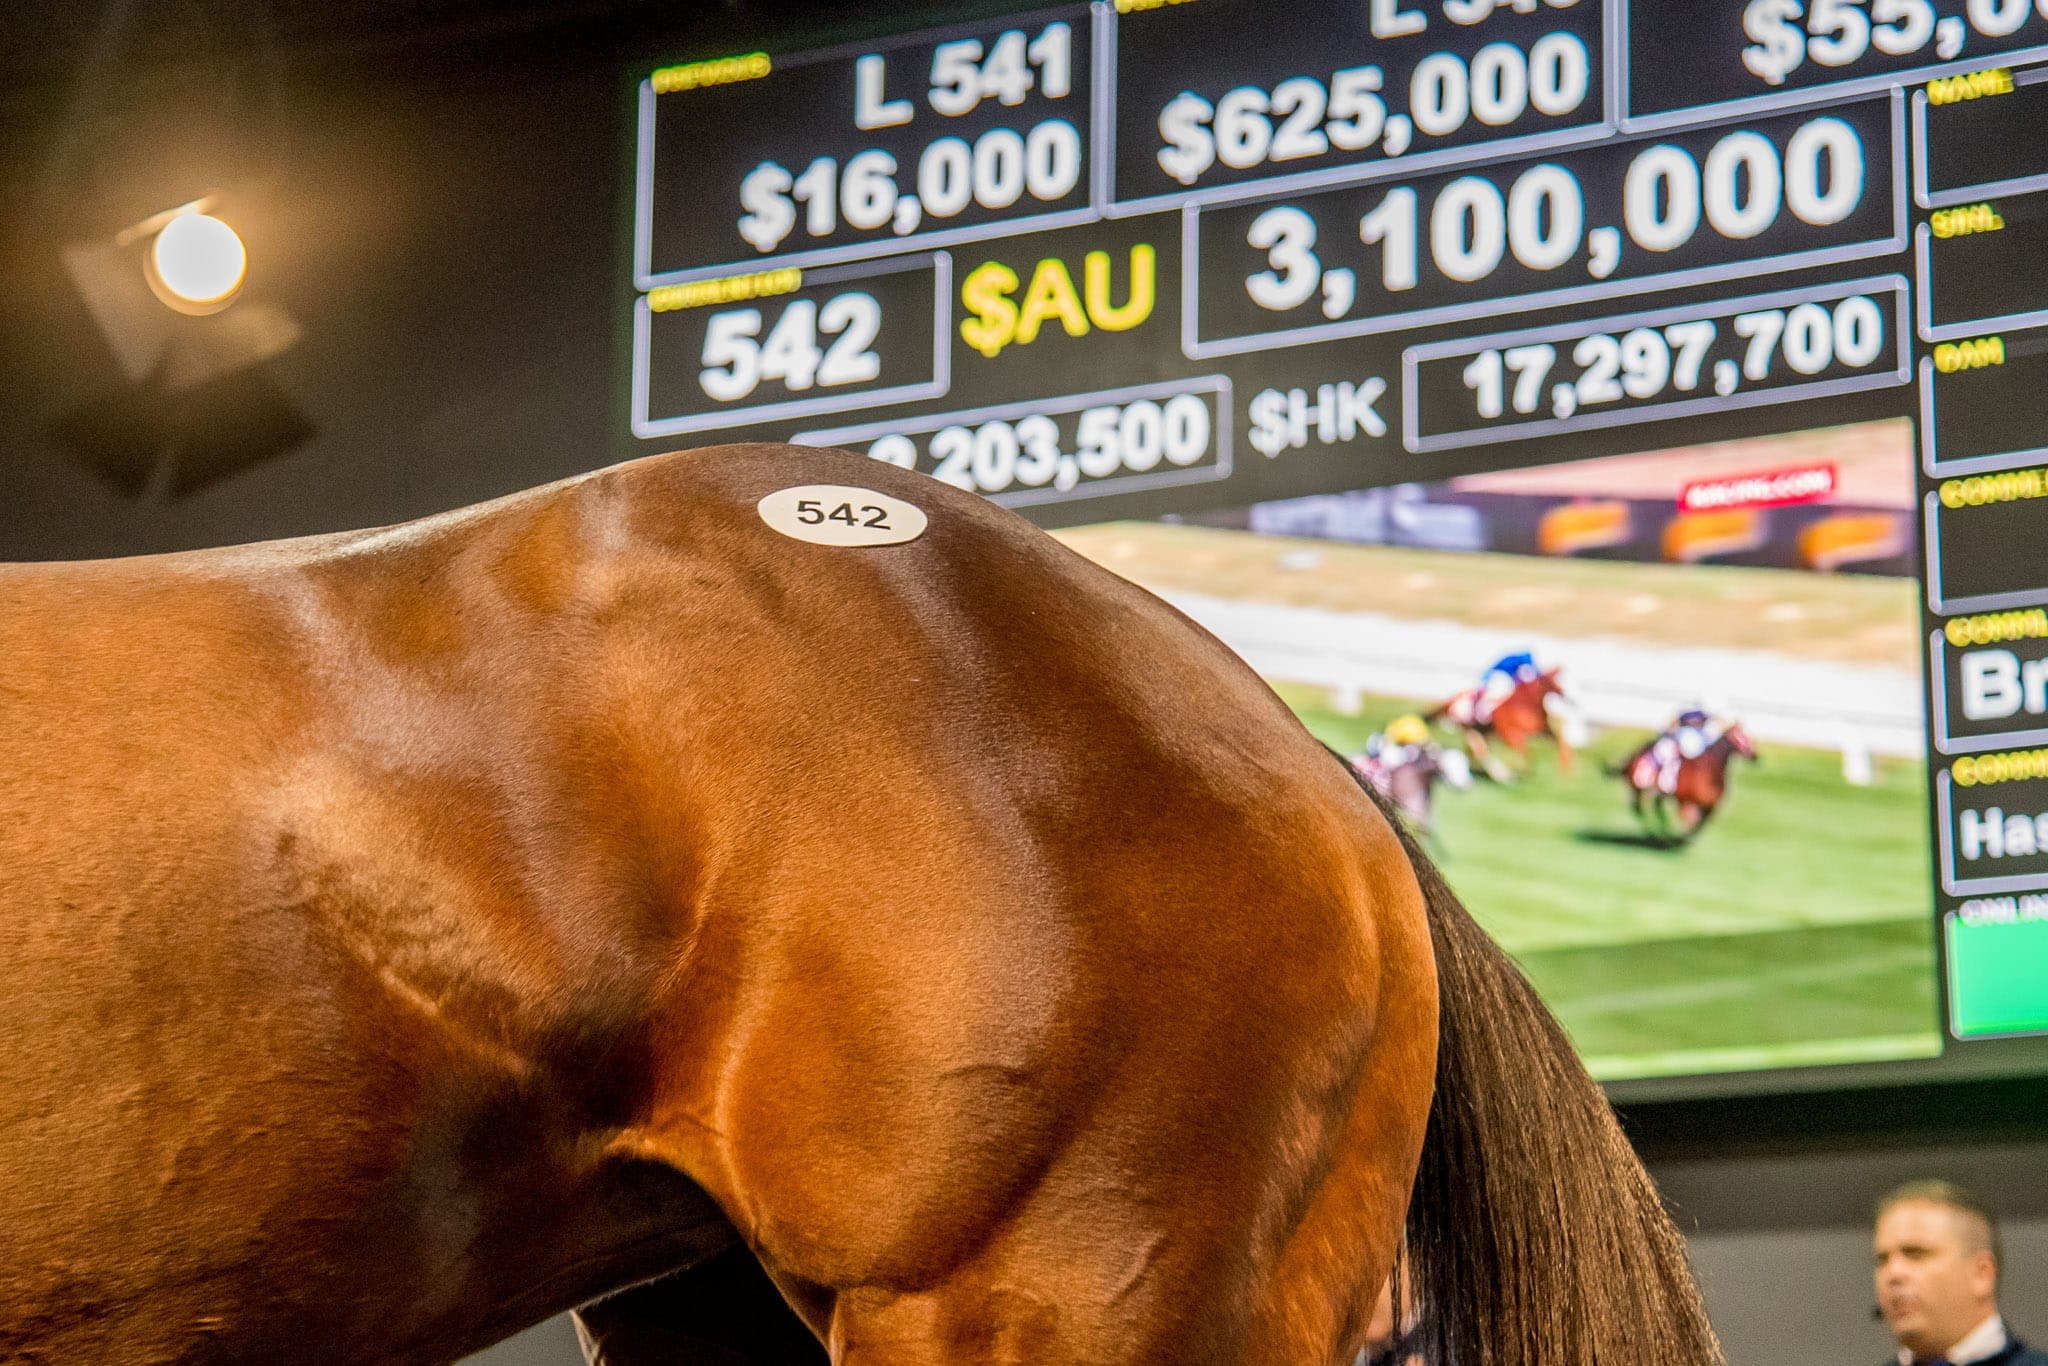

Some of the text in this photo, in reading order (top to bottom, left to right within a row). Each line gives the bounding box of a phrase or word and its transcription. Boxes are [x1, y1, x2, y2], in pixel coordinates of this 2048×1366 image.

[855, 53, 914, 130] L
[927, 21, 1072, 117] 541
[1157, 30, 1590, 186] $625,000
[738, 118, 1081, 252] $16,000
[1245, 116, 1865, 320] 3,100,000
[700, 292, 882, 402] 542
[960, 244, 1156, 358] $AU
[1462, 296, 1884, 419] 17,297,700
[1248, 376, 1388, 458] $HK
[796, 499, 893, 531] 542
